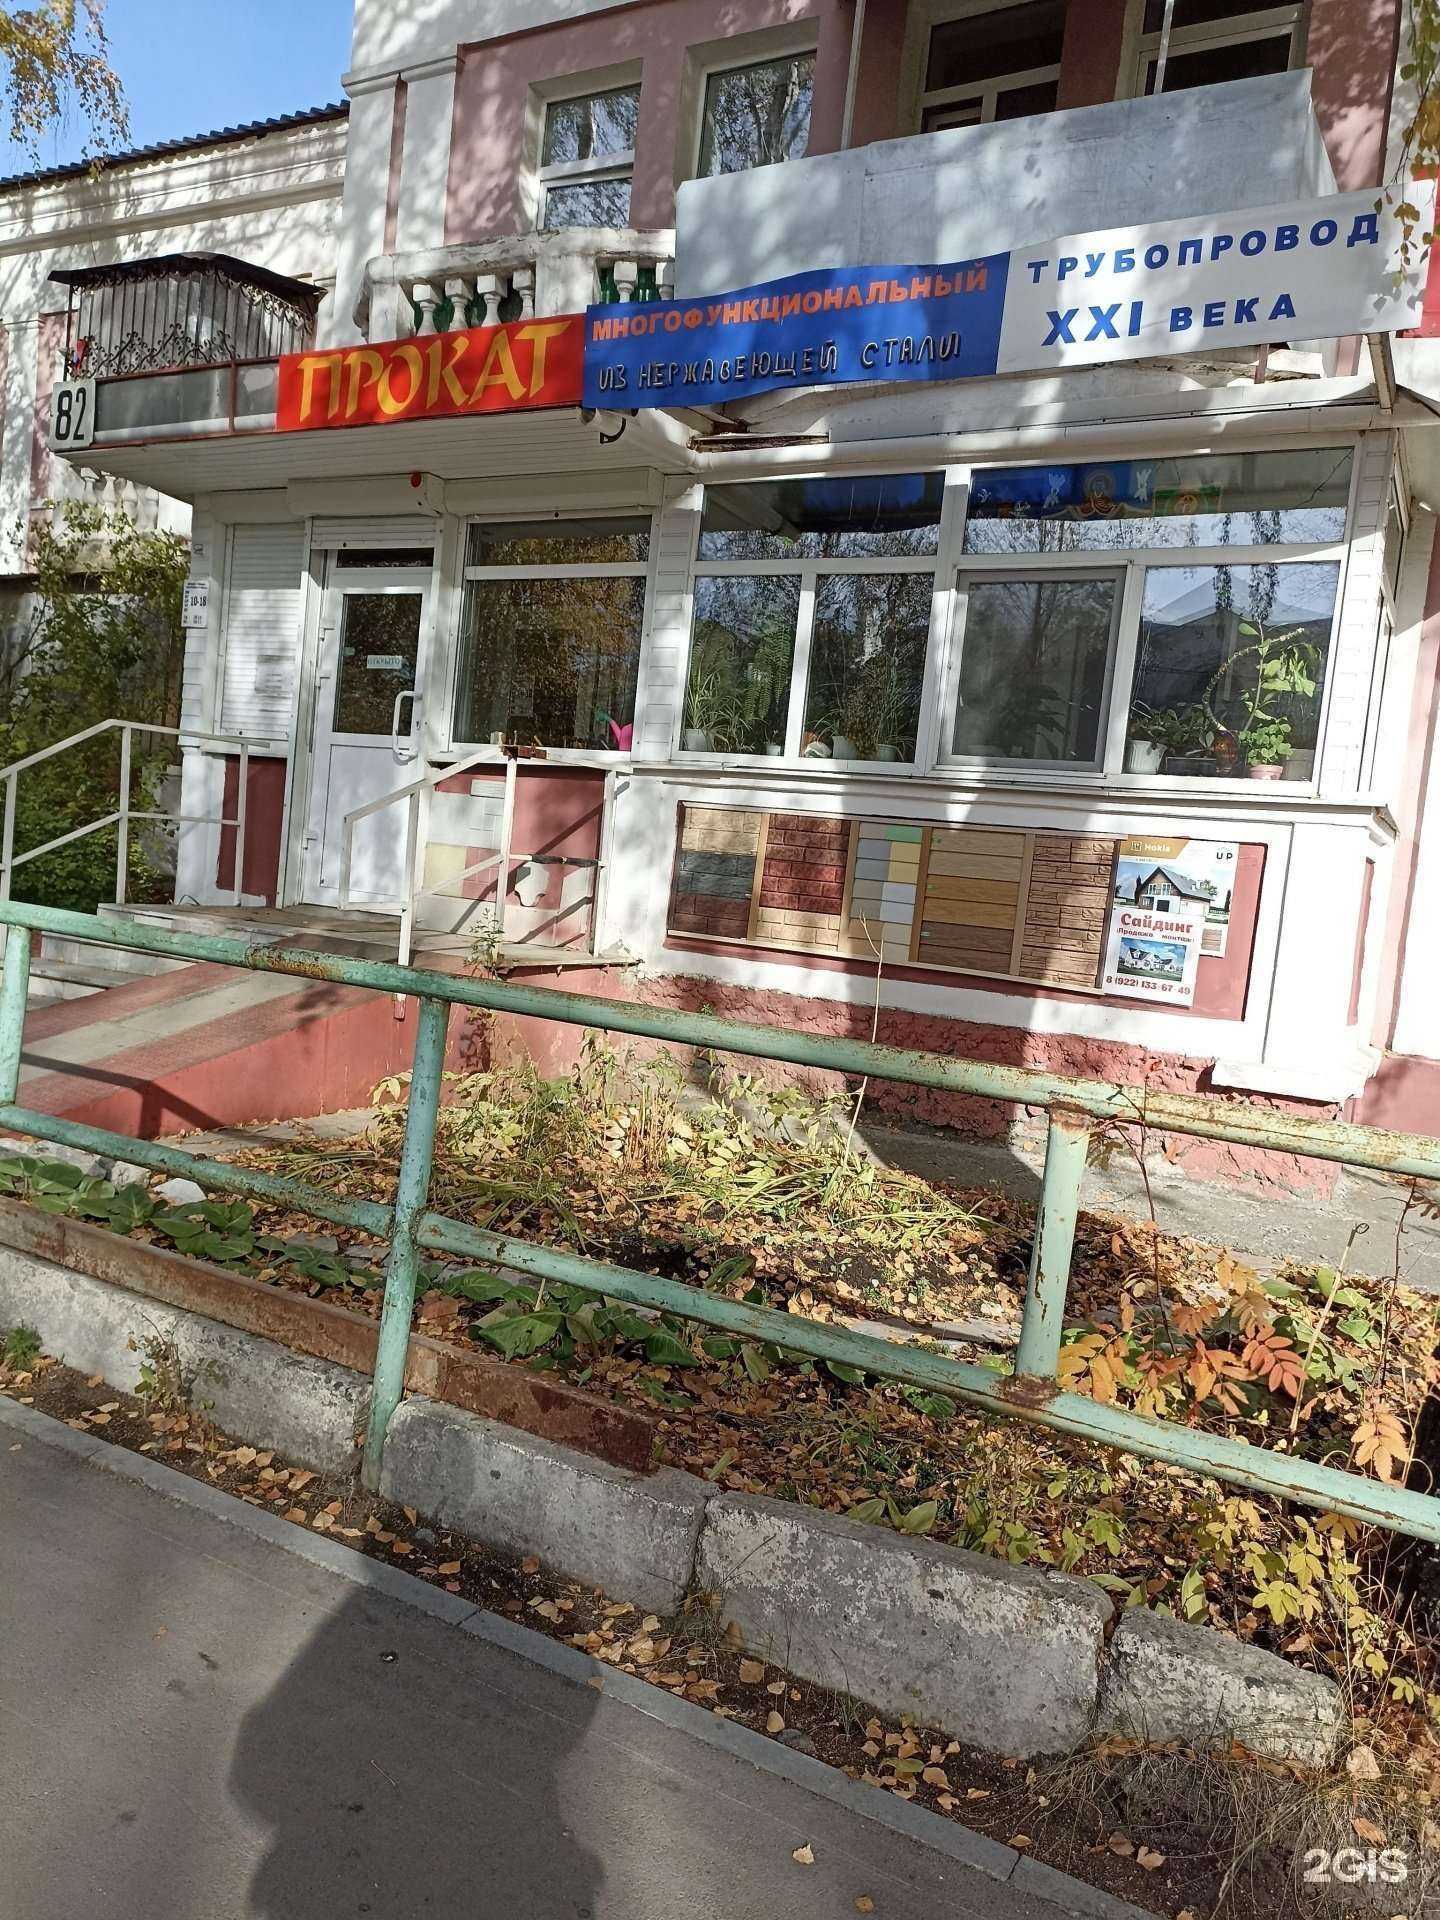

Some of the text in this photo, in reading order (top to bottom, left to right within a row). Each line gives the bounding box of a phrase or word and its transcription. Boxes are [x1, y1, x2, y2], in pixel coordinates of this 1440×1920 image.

[1027, 213, 1380, 285] ТРУБОПРОВОД
[592, 261, 988, 342] МНОГОФУНКЦИОНАЛЬНЫЙ
[1041, 293, 1296, 347] XXI ВЕКА
[297, 319, 572, 424] ПРОКАТ
[599, 331, 961, 392] ИЗ НЕРЖАВЕЮЩЕЙ СТАЛИ
[55, 387, 87, 440] 82
[1120, 913, 1194, 934] Сайдинг
[1106, 975, 1113, 983] 8
[1115, 976, 1139, 988] (922)
